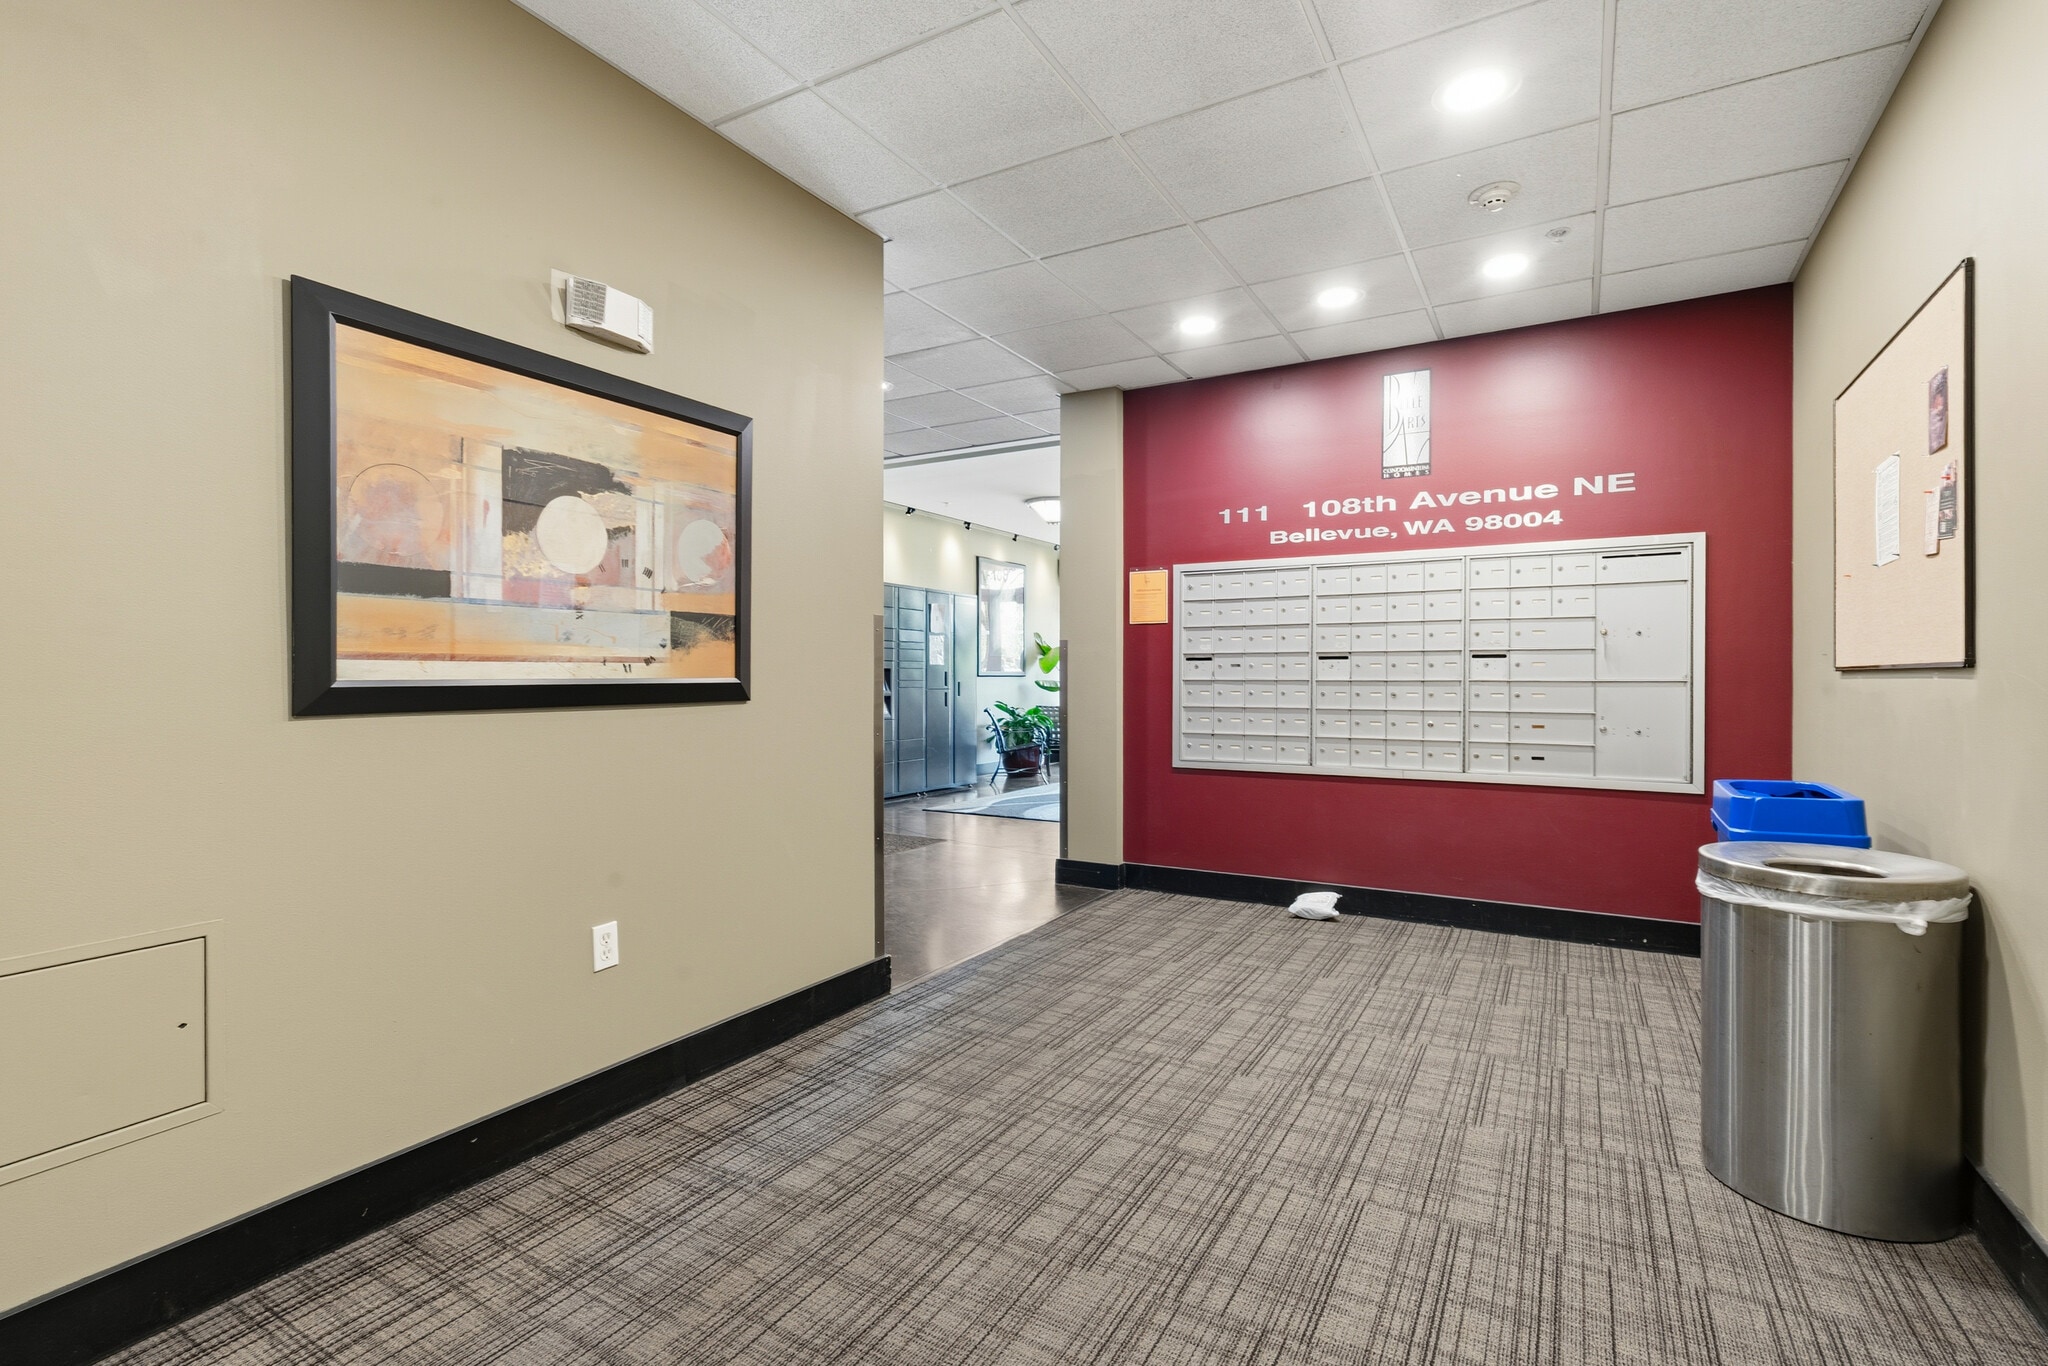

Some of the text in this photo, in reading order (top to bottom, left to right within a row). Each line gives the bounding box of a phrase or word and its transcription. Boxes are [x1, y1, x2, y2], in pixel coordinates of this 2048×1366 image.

[1218, 472, 1637, 524] 111 108th Avenue NE
[1269, 509, 1564, 545] Bellevue, WA 98004
